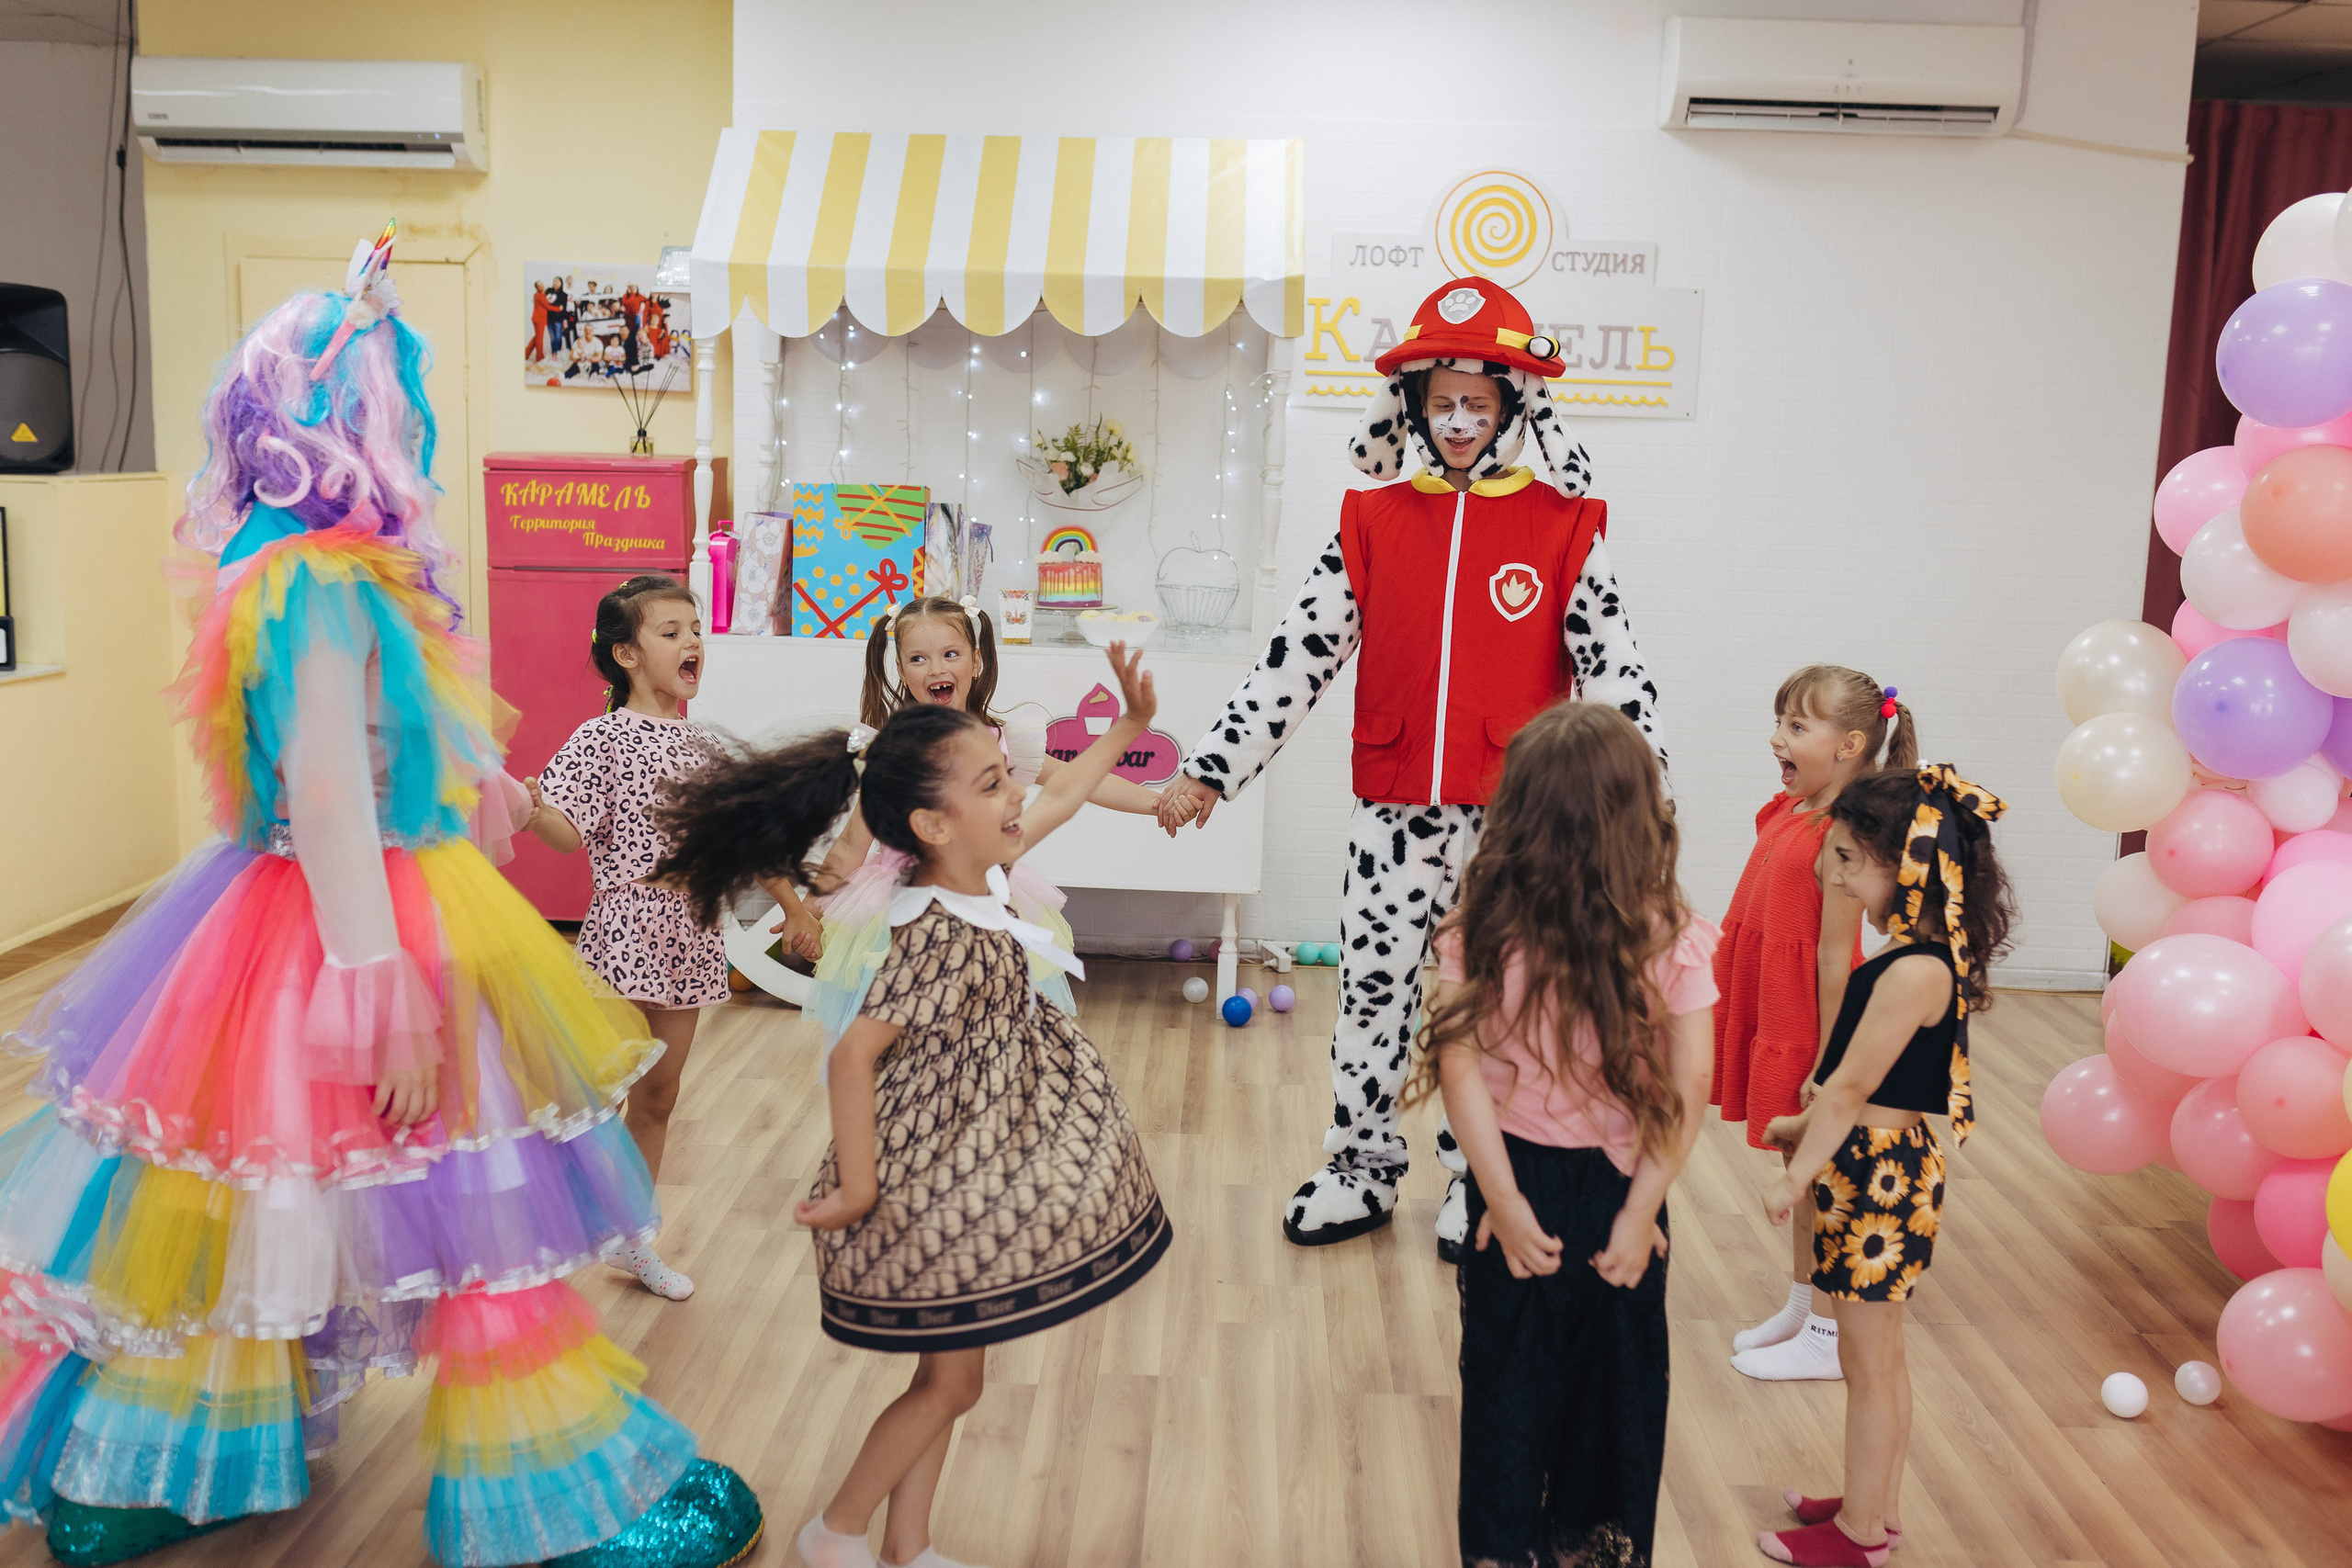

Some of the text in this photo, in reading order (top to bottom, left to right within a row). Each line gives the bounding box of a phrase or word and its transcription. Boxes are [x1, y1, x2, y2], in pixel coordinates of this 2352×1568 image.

[1350, 244, 1645, 276] ЛОФТ СТУДИЯ
[1305, 297, 1676, 371] КАЕЛЬ
[501, 479, 651, 512] КАРАМЕЛЬ
[510, 514, 595, 534] Территория
[582, 532, 665, 552] Праздника
